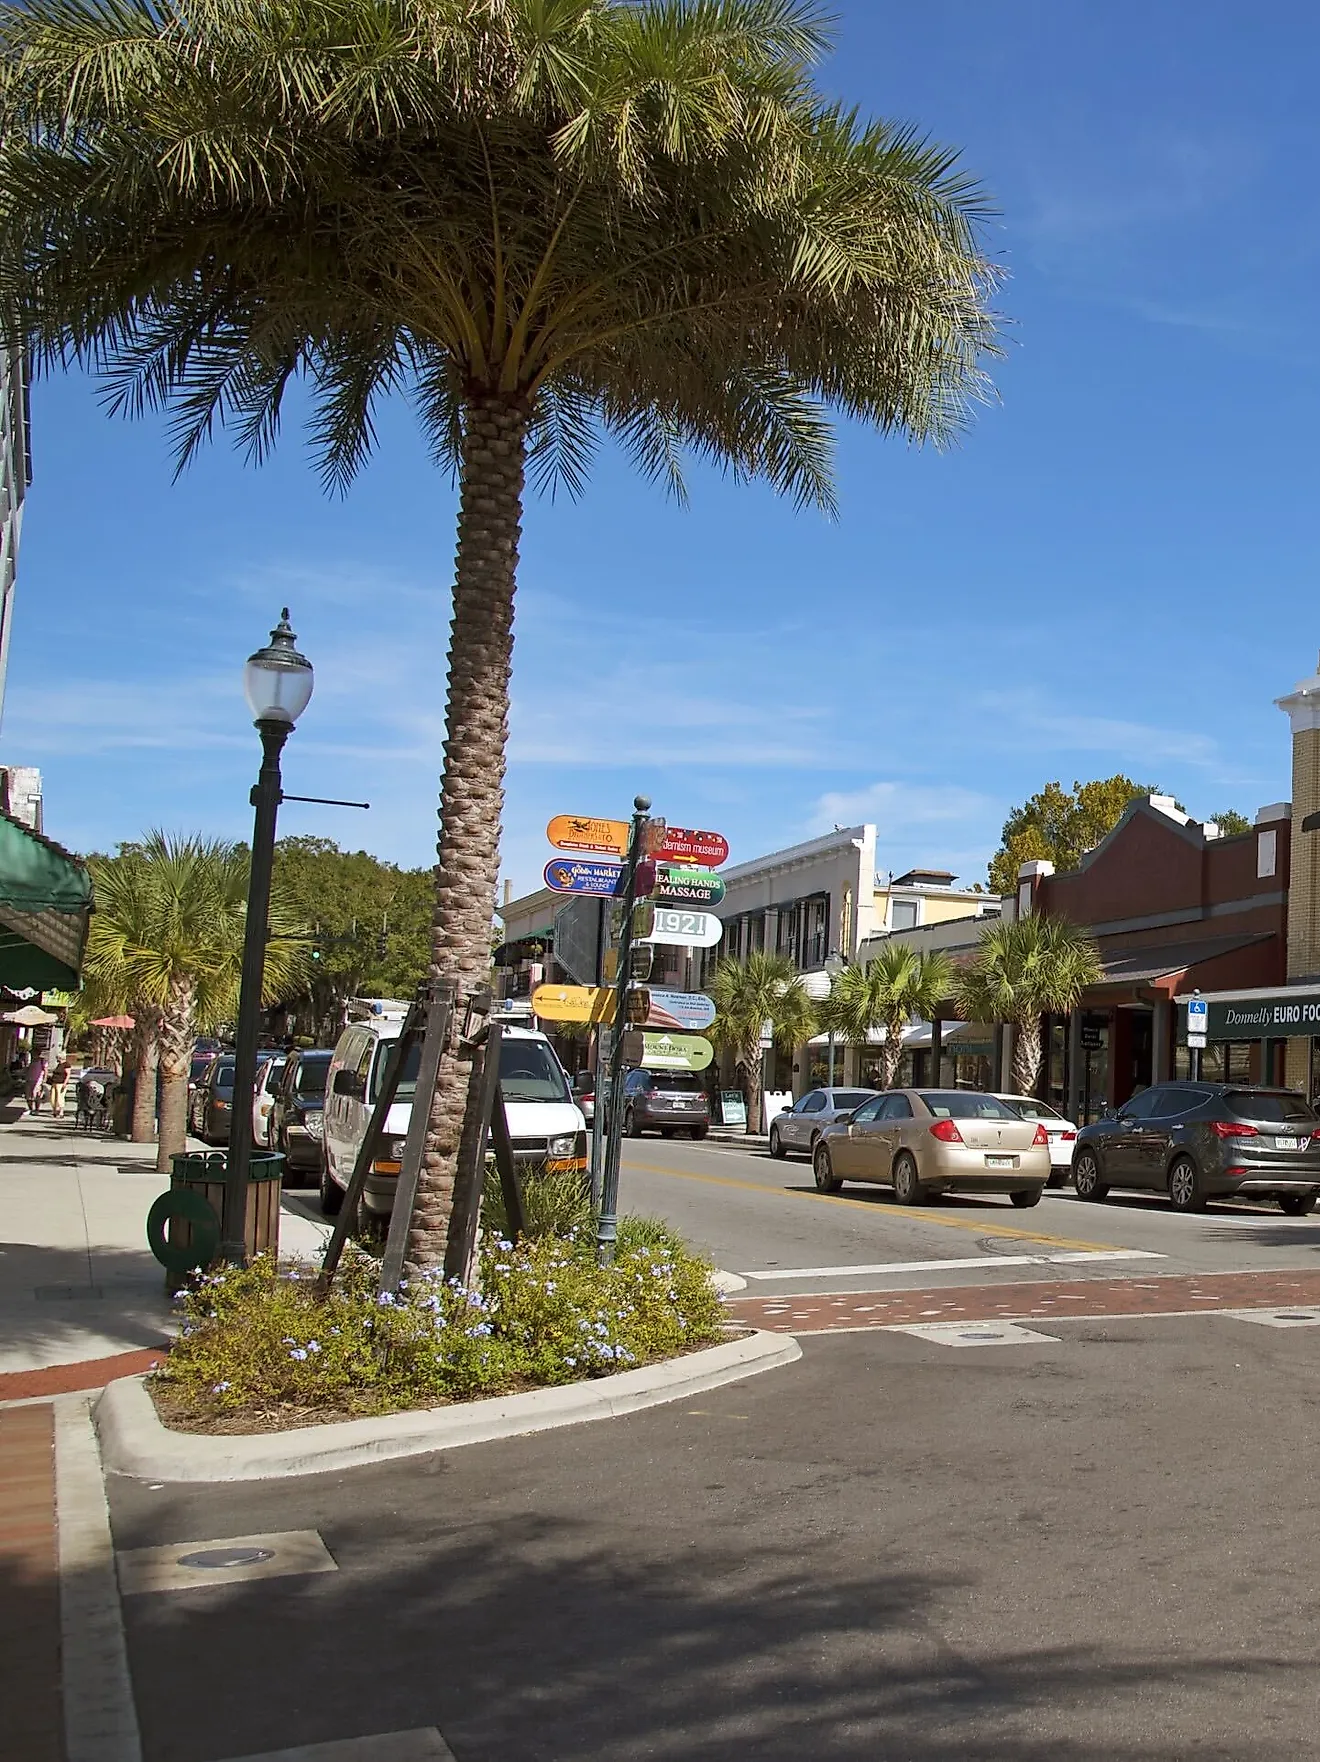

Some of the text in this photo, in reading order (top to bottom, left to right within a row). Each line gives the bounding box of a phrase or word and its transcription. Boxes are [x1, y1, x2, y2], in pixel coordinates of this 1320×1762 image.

[663, 839, 724, 857] dernism museum
[660, 885, 711, 900] MASSAGE
[691, 878, 721, 889] HANDS
[656, 911, 707, 936] 1921
[1225, 1008, 1272, 1027] Donnelly
[1273, 1005, 1300, 1023] EURO
